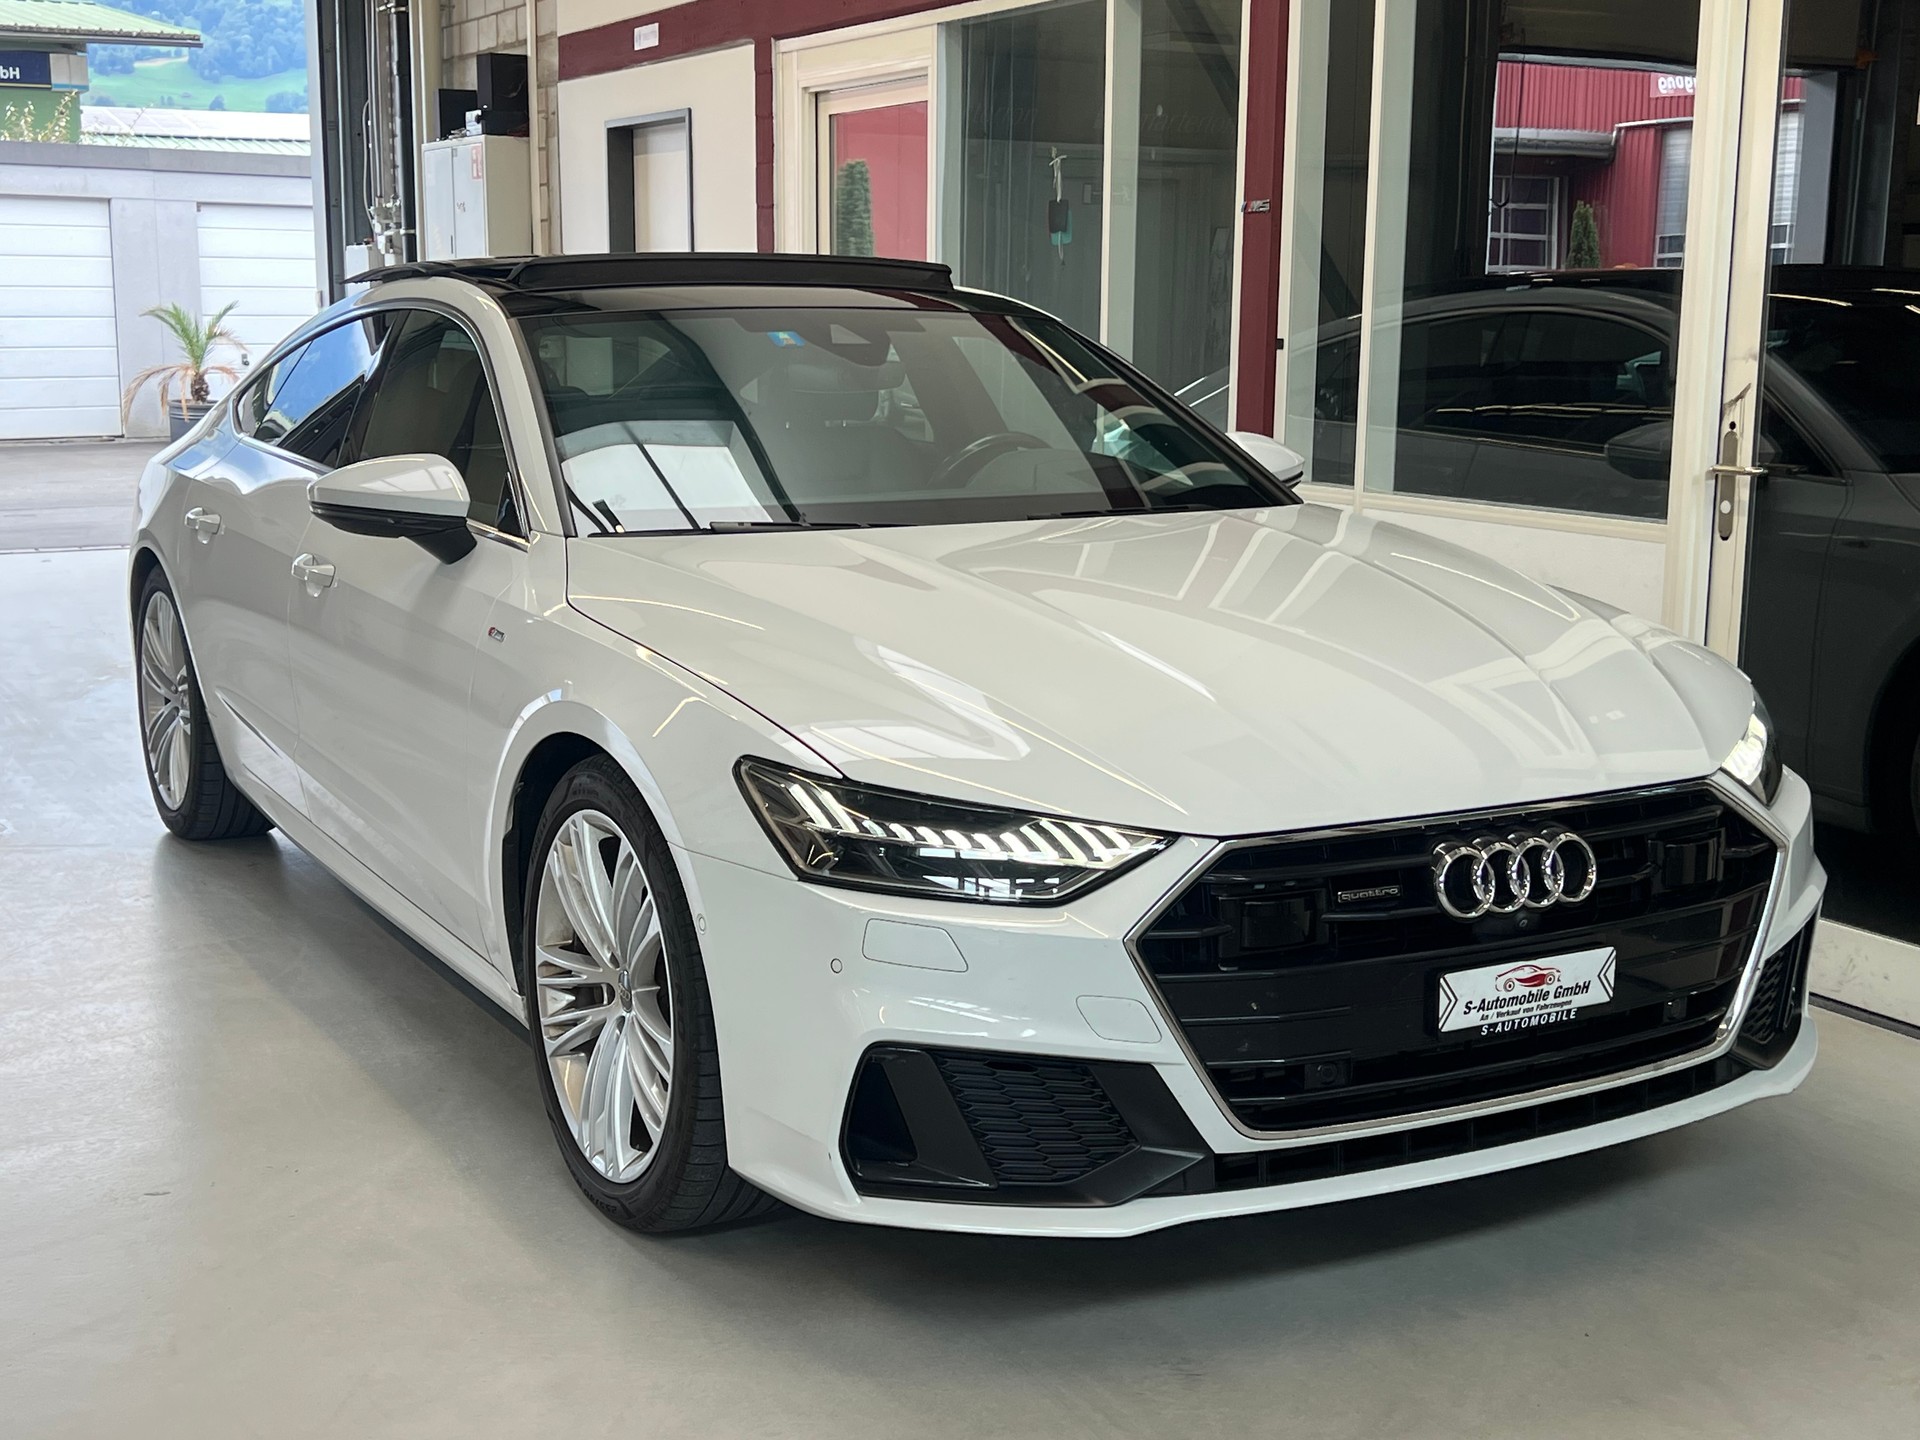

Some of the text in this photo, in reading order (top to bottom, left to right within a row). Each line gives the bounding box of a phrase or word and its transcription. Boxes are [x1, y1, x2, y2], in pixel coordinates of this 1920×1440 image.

[1341, 887, 1399, 901] quattro
[1464, 980, 1591, 1015] S-Automobile GmbH
[1480, 1014, 1490, 1022] An
[1496, 1006, 1521, 1019] Verkauf
[1522, 1006, 1535, 1014] von
[1535, 999, 1573, 1012] Fahrzeugen
[1480, 1008, 1578, 1036] S-AUTOMOBILE
